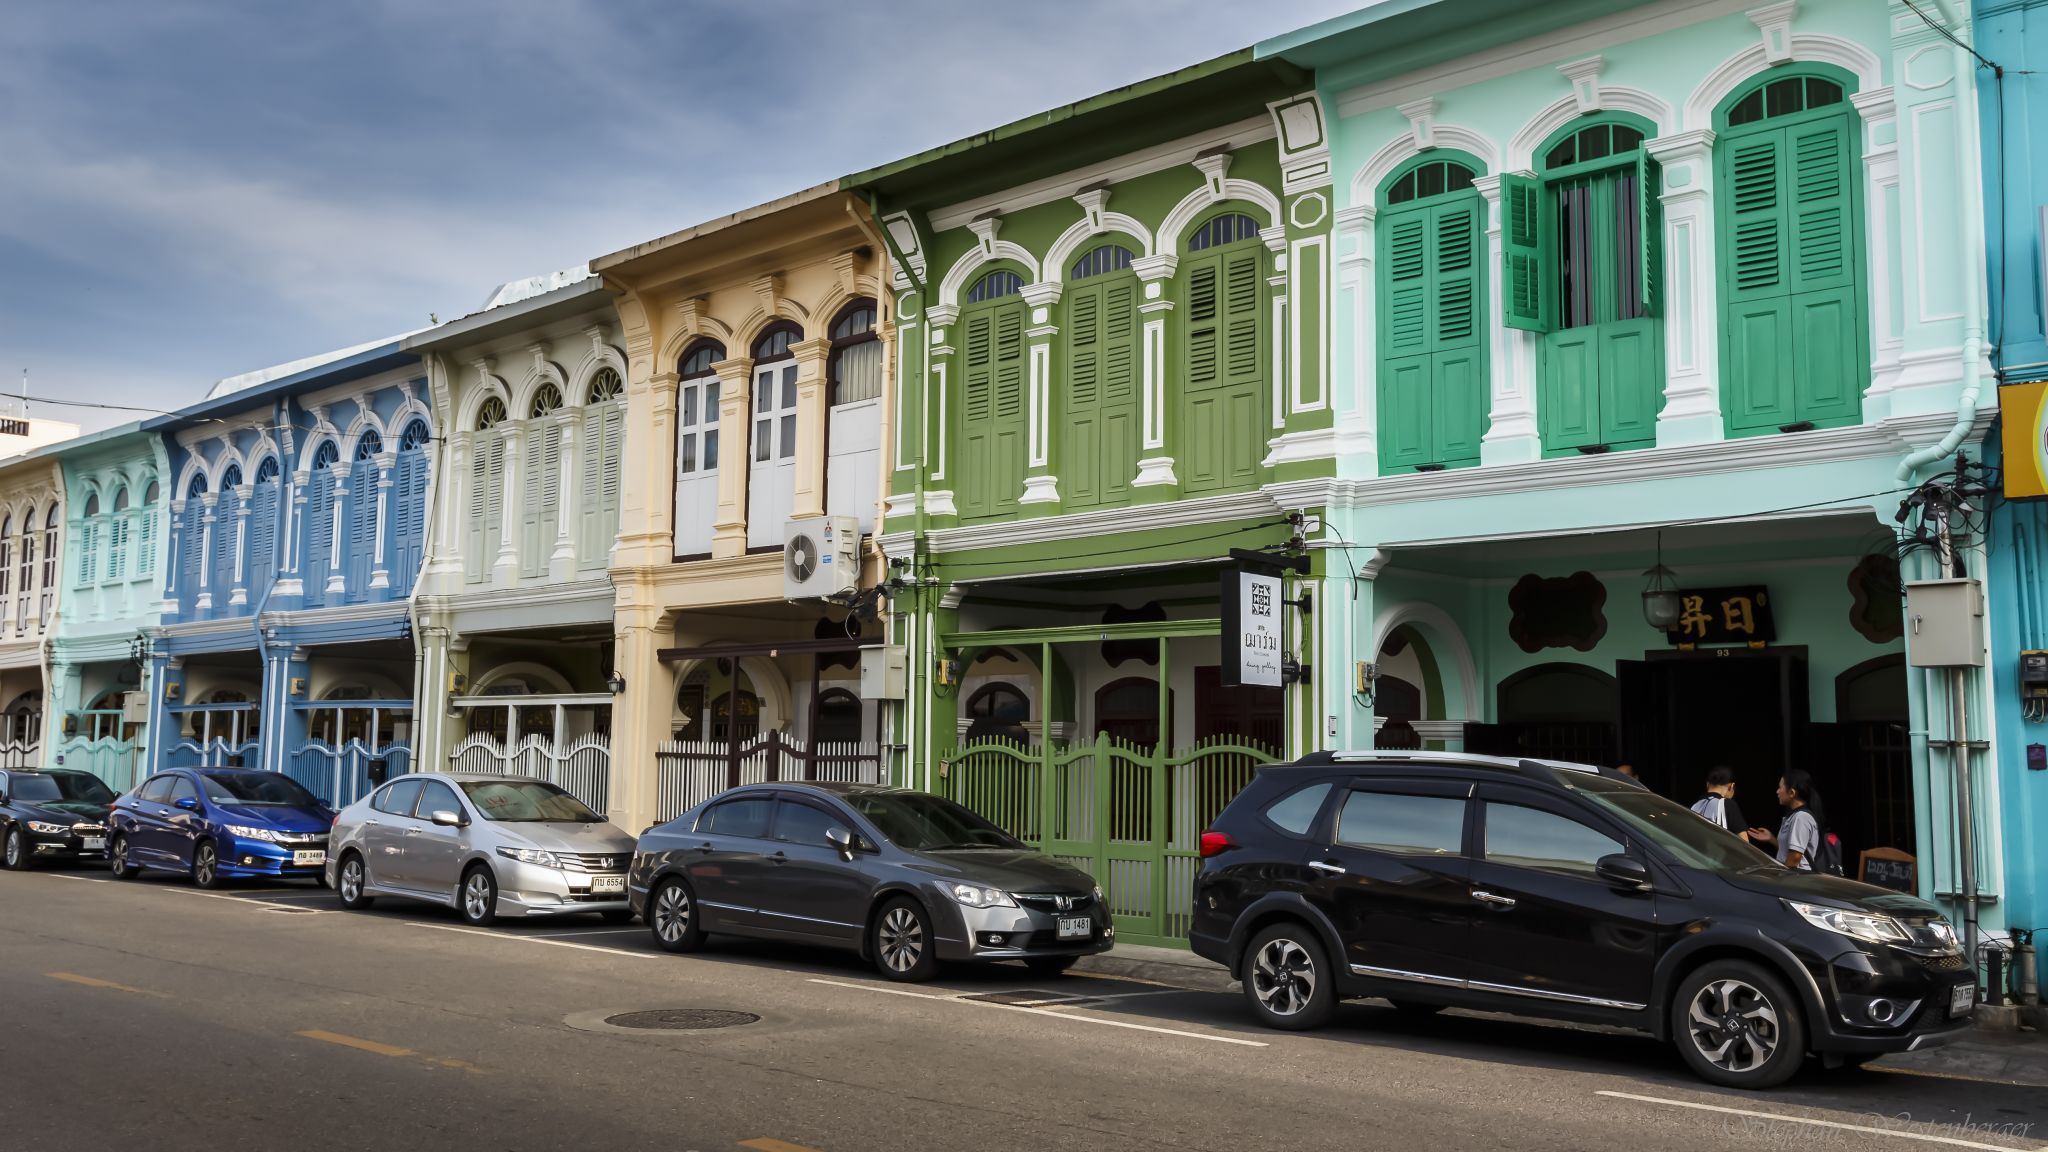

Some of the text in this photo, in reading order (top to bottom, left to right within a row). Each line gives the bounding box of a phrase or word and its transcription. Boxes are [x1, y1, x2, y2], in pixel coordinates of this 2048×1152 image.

[1716, 649, 1730, 657] 93
[607, 878, 622, 887] 6554
[1073, 918, 1088, 930] 1481
